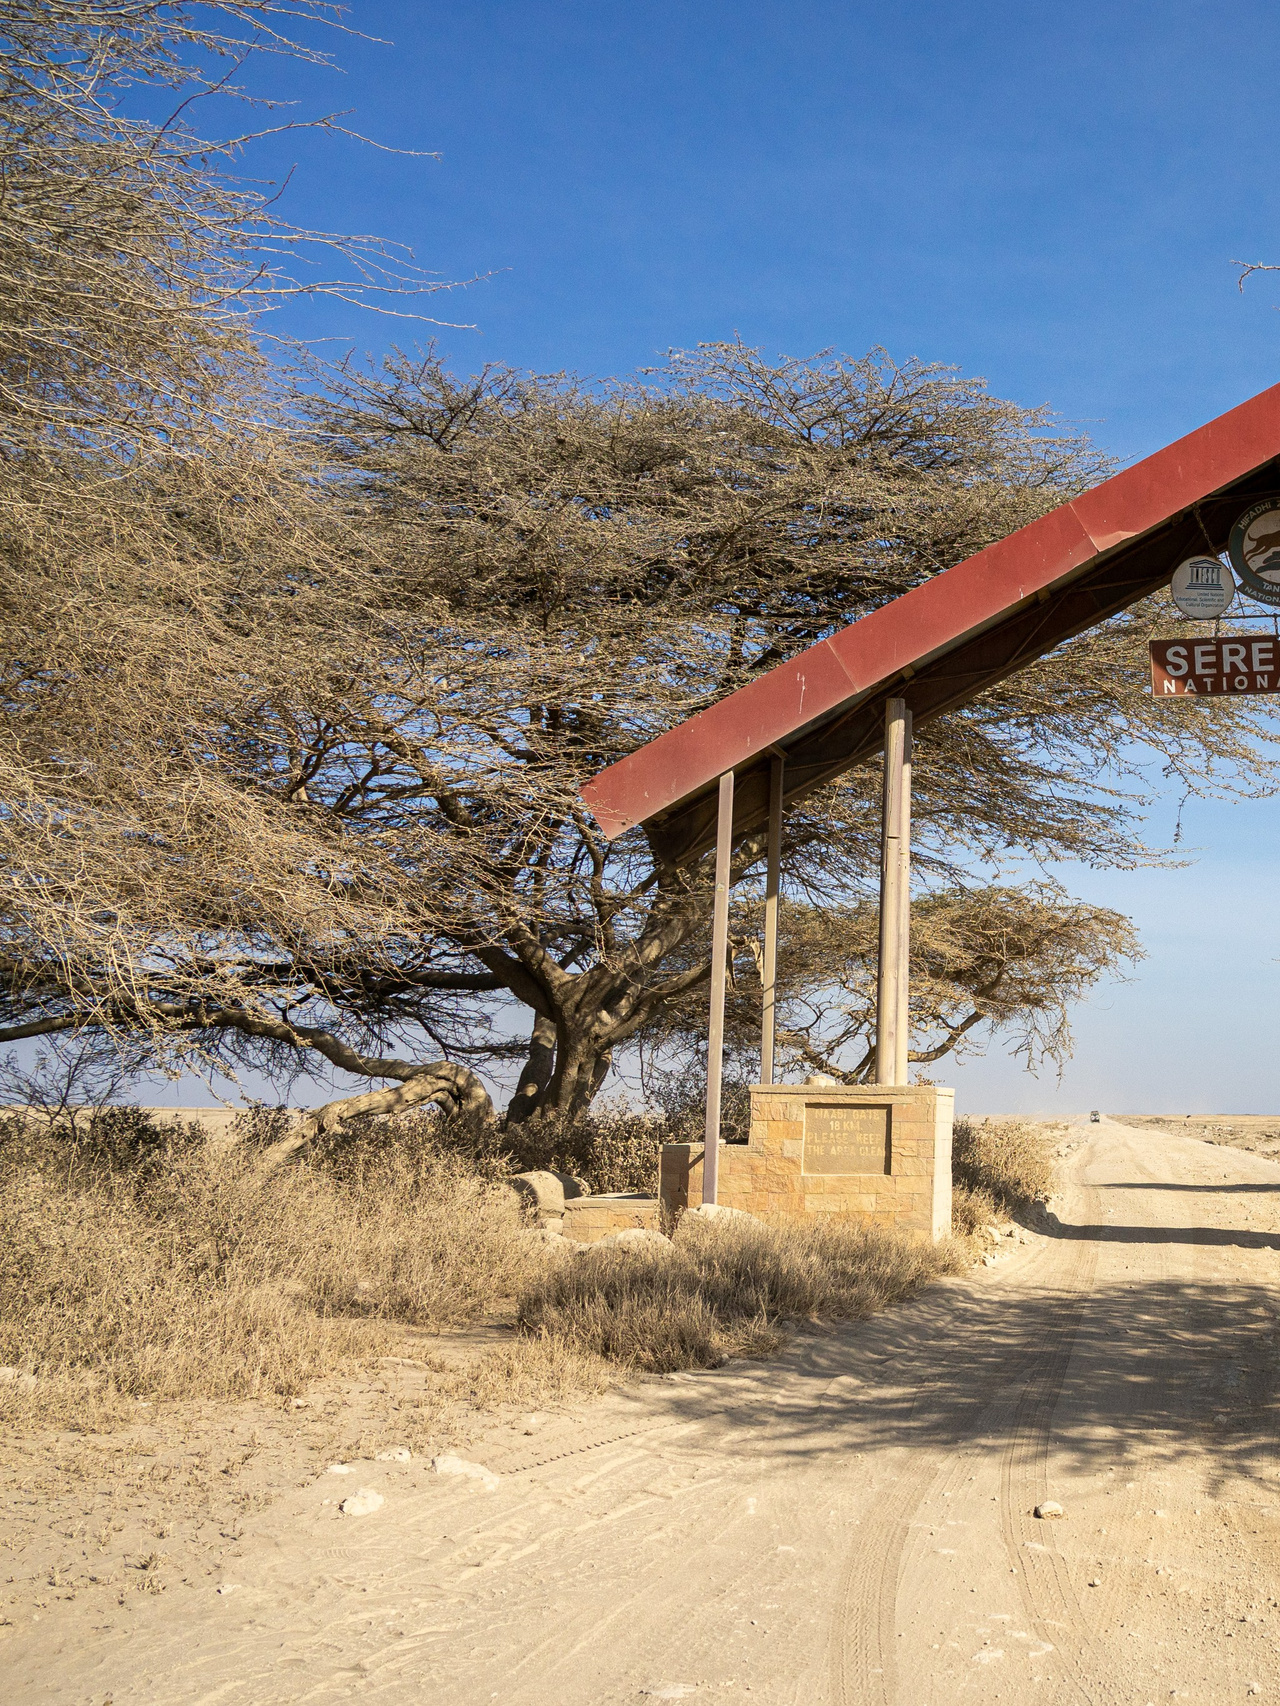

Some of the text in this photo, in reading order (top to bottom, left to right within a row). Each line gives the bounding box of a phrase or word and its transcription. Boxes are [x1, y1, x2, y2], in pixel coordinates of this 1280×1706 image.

[1238, 501, 1271, 530] HIFADHI
[852, 1110, 880, 1120] GATE
[830, 1120, 840, 1131] 18
[807, 1132, 881, 1144] PLEASE KEEP
[806, 1145, 825, 1155] THE
[830, 1145, 856, 1156] AREA
